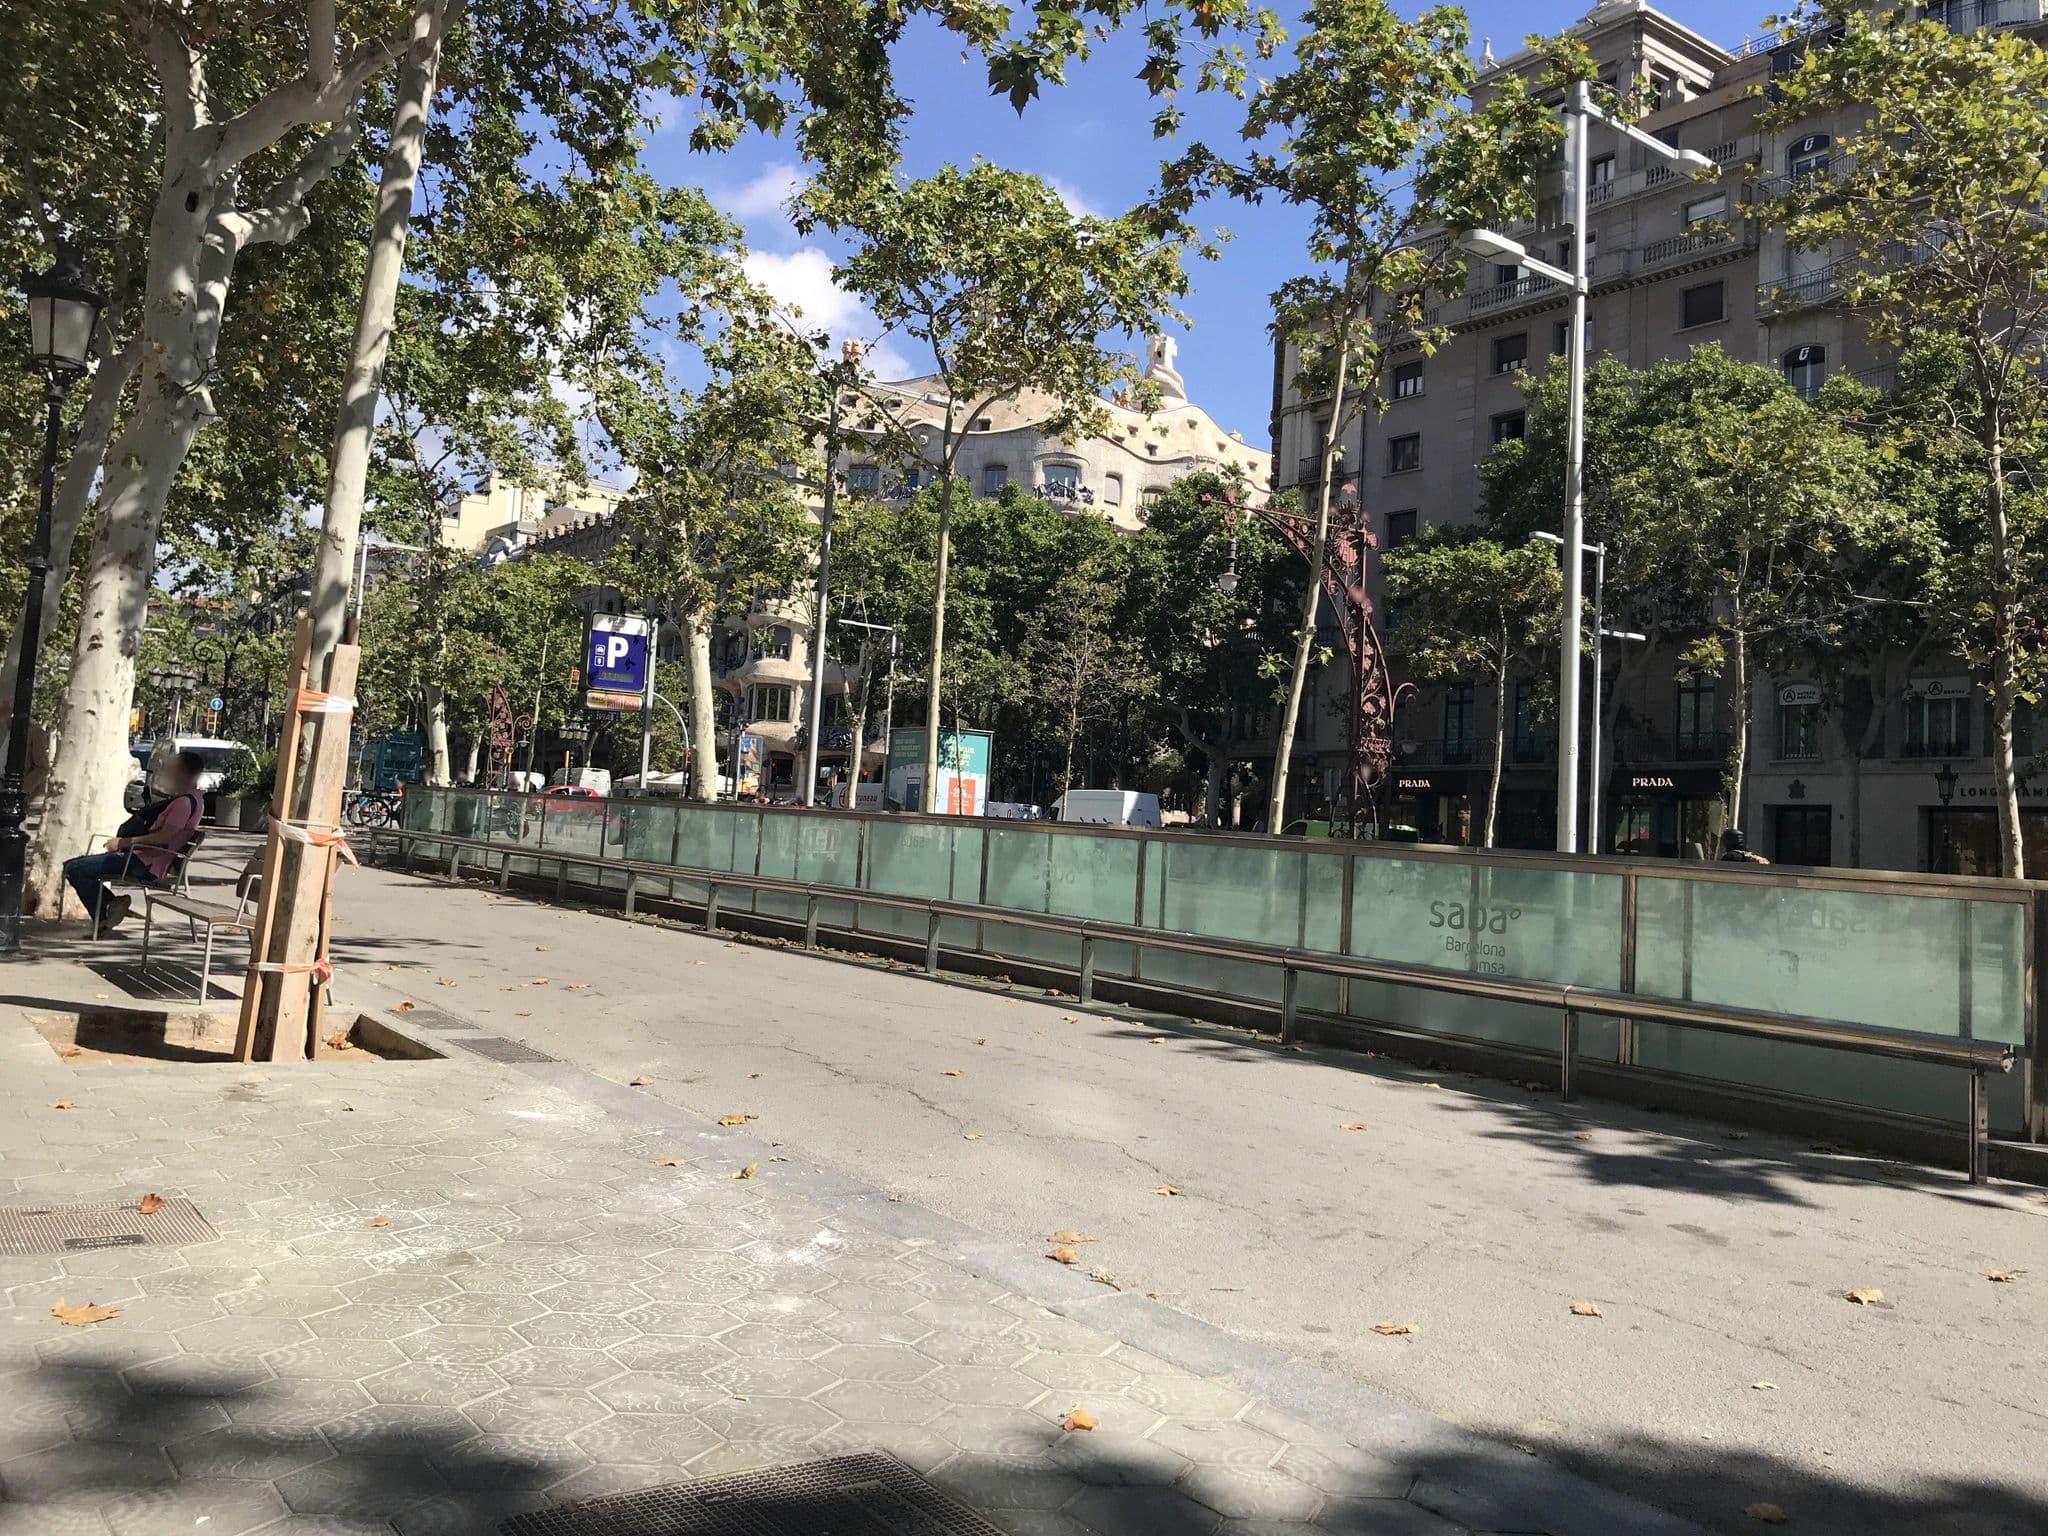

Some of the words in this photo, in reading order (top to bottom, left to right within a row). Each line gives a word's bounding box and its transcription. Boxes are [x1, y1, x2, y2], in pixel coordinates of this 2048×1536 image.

[606, 635, 629, 668] P
[1399, 779, 1431, 788] PRADA
[1632, 777, 1674, 787] PRADA
[1446, 936, 1506, 957] Barclona
